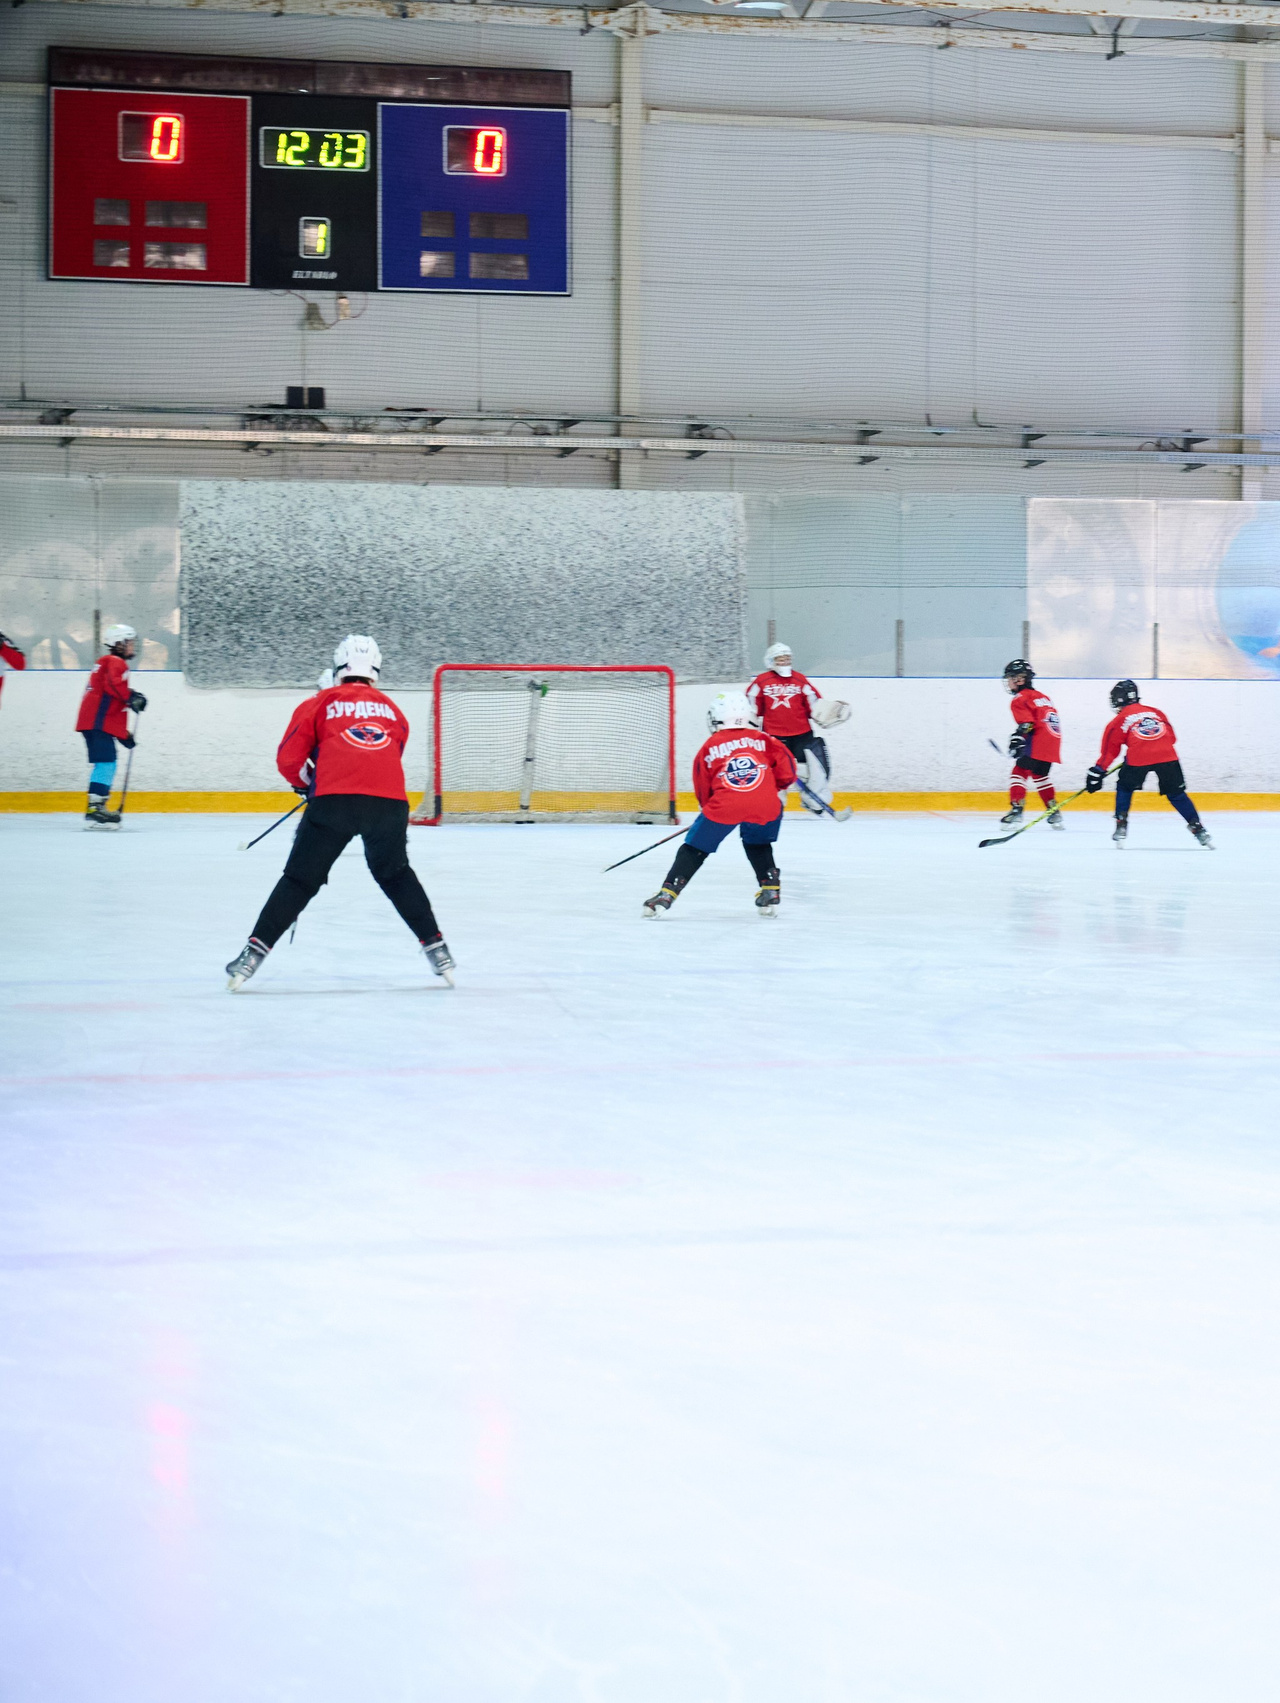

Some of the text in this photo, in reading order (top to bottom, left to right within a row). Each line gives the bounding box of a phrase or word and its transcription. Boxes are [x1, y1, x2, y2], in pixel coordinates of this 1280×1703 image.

[150, 116, 181, 160] 0
[474, 130, 503, 172] 0
[316, 223, 328, 253] 1
